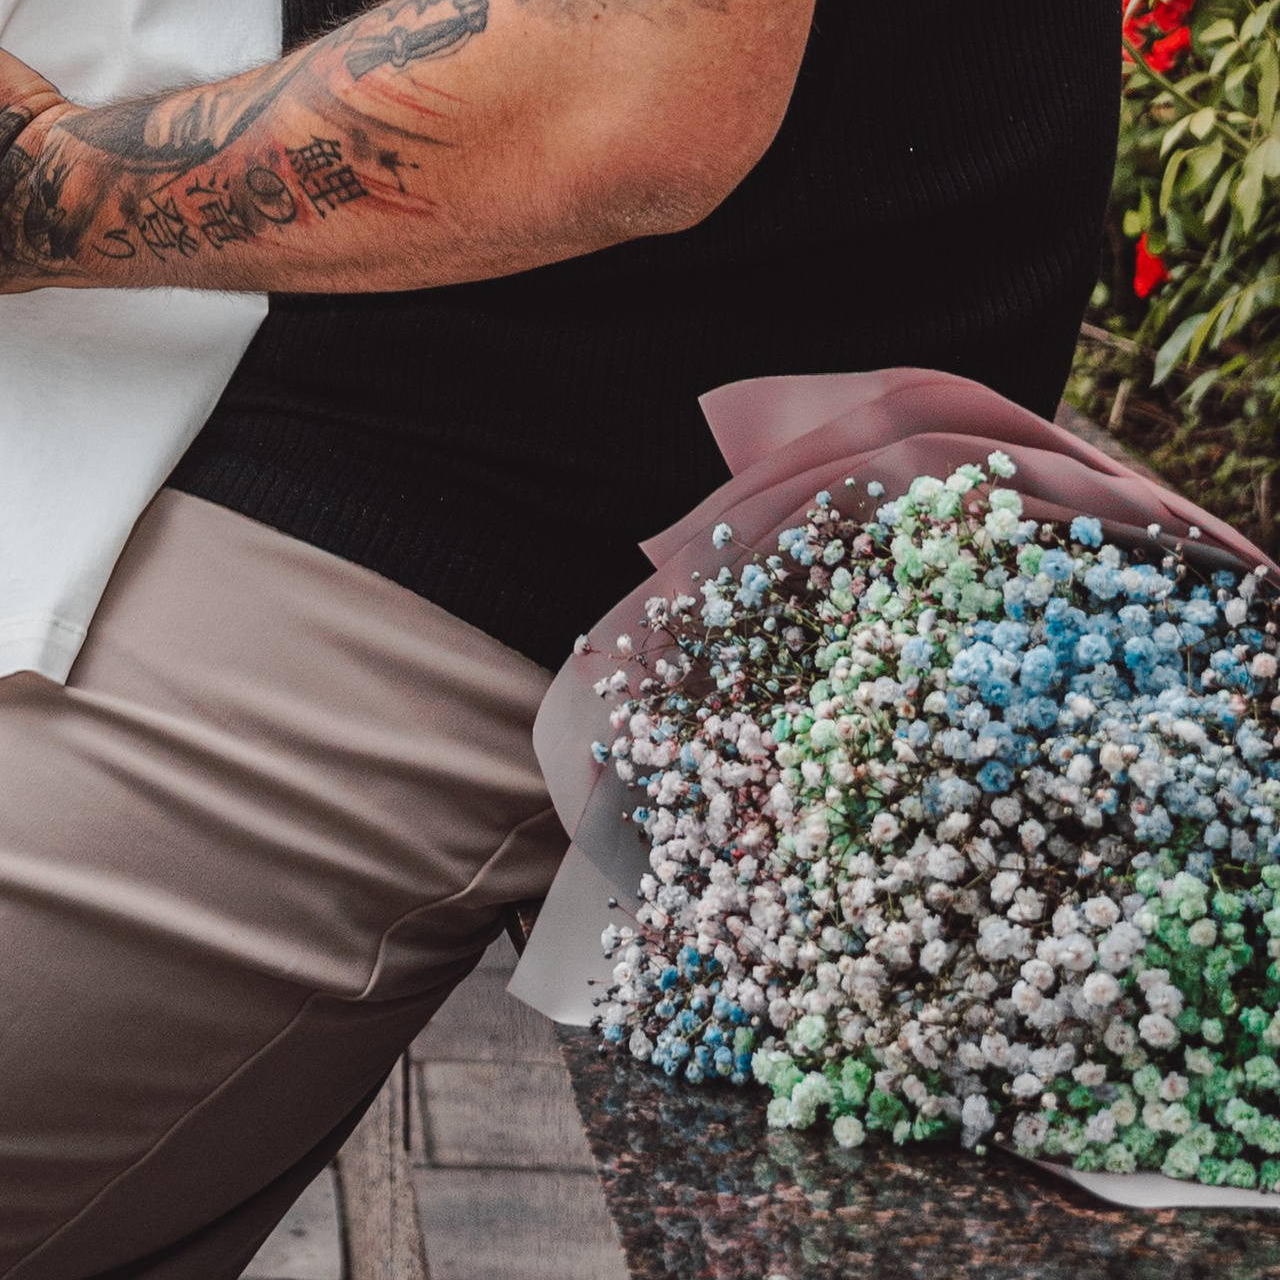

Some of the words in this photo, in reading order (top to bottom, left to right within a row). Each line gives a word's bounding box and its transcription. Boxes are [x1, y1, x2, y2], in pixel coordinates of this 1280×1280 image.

[91, 134, 369, 262] 鯉の滝登り
